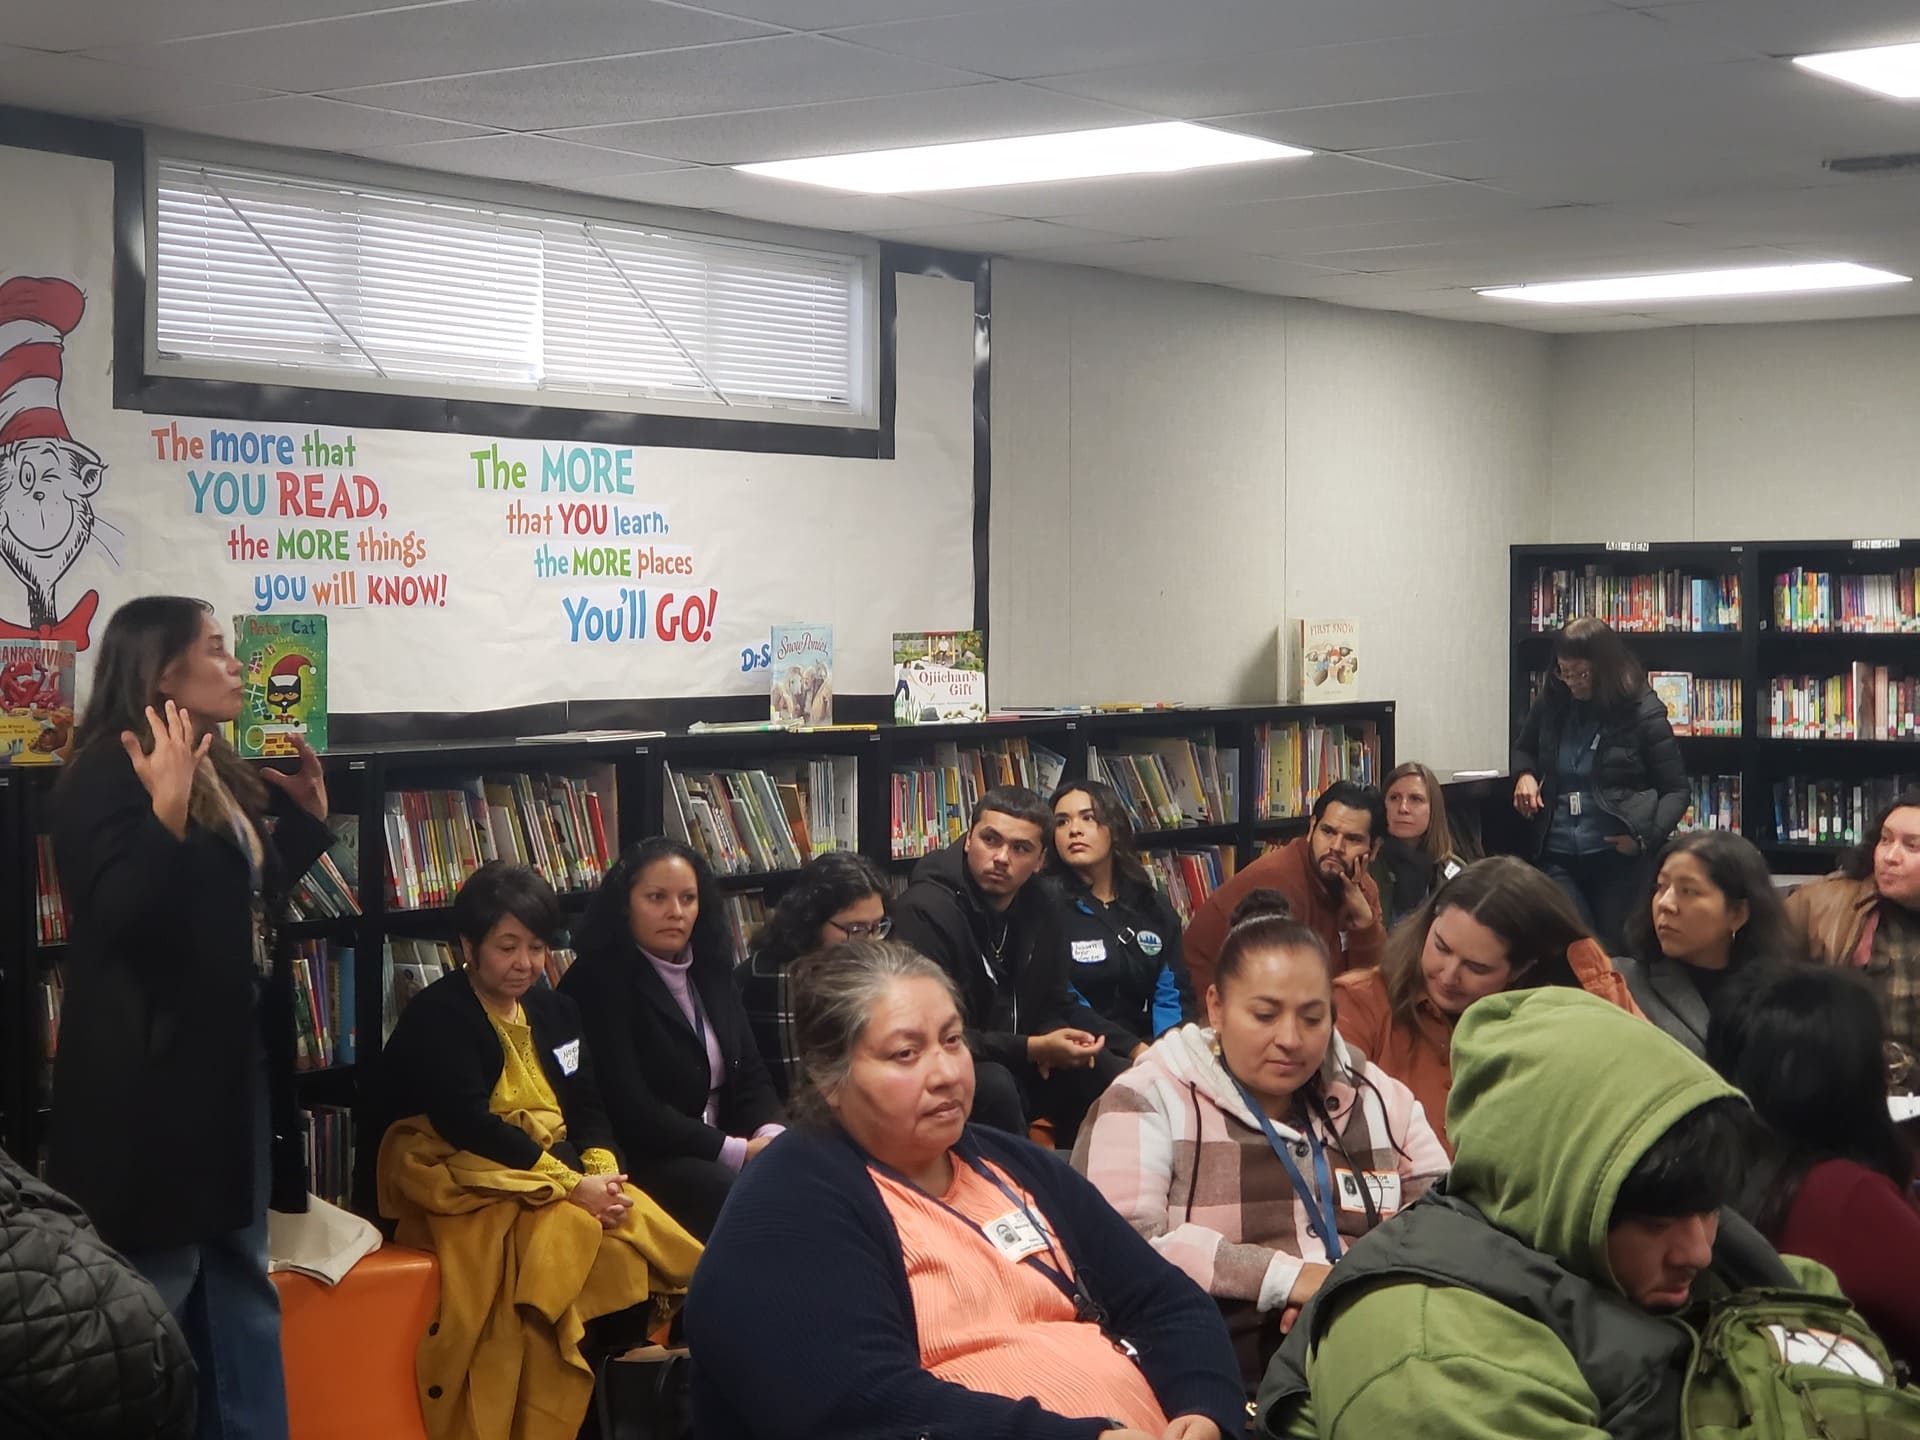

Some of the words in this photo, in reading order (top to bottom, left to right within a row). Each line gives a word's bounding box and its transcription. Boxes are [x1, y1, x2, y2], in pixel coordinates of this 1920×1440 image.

[151, 422, 204, 461] The
[210, 430, 294, 465] more
[301, 429, 356, 467] that
[470, 443, 527, 490] The
[541, 445, 634, 494] MORE
[187, 470, 266, 516] YOU
[276, 472, 388, 520] READ,
[506, 499, 552, 535] that
[558, 503, 608, 536] YOU
[613, 506, 669, 536] learn,
[227, 525, 269, 561] the
[277, 528, 349, 561] MORE
[357, 526, 427, 568] things
[534, 543, 569, 578] the
[572, 546, 631, 578] MORE
[637, 545, 693, 579] places
[254, 574, 306, 611] you
[312, 571, 356, 606] will
[367, 574, 447, 607] KNOW!
[249, 619, 280, 636] Pete
[291, 618, 316, 635] Cat
[562, 587, 646, 643] You'll
[655, 588, 719, 643] GO!
[1310, 623, 1330, 636] FIRST
[1332, 623, 1354, 633] SNOW
[777, 635, 803, 660] Snow
[919, 671, 978, 687] Ojiichan's
[949, 683, 973, 696] Gift
